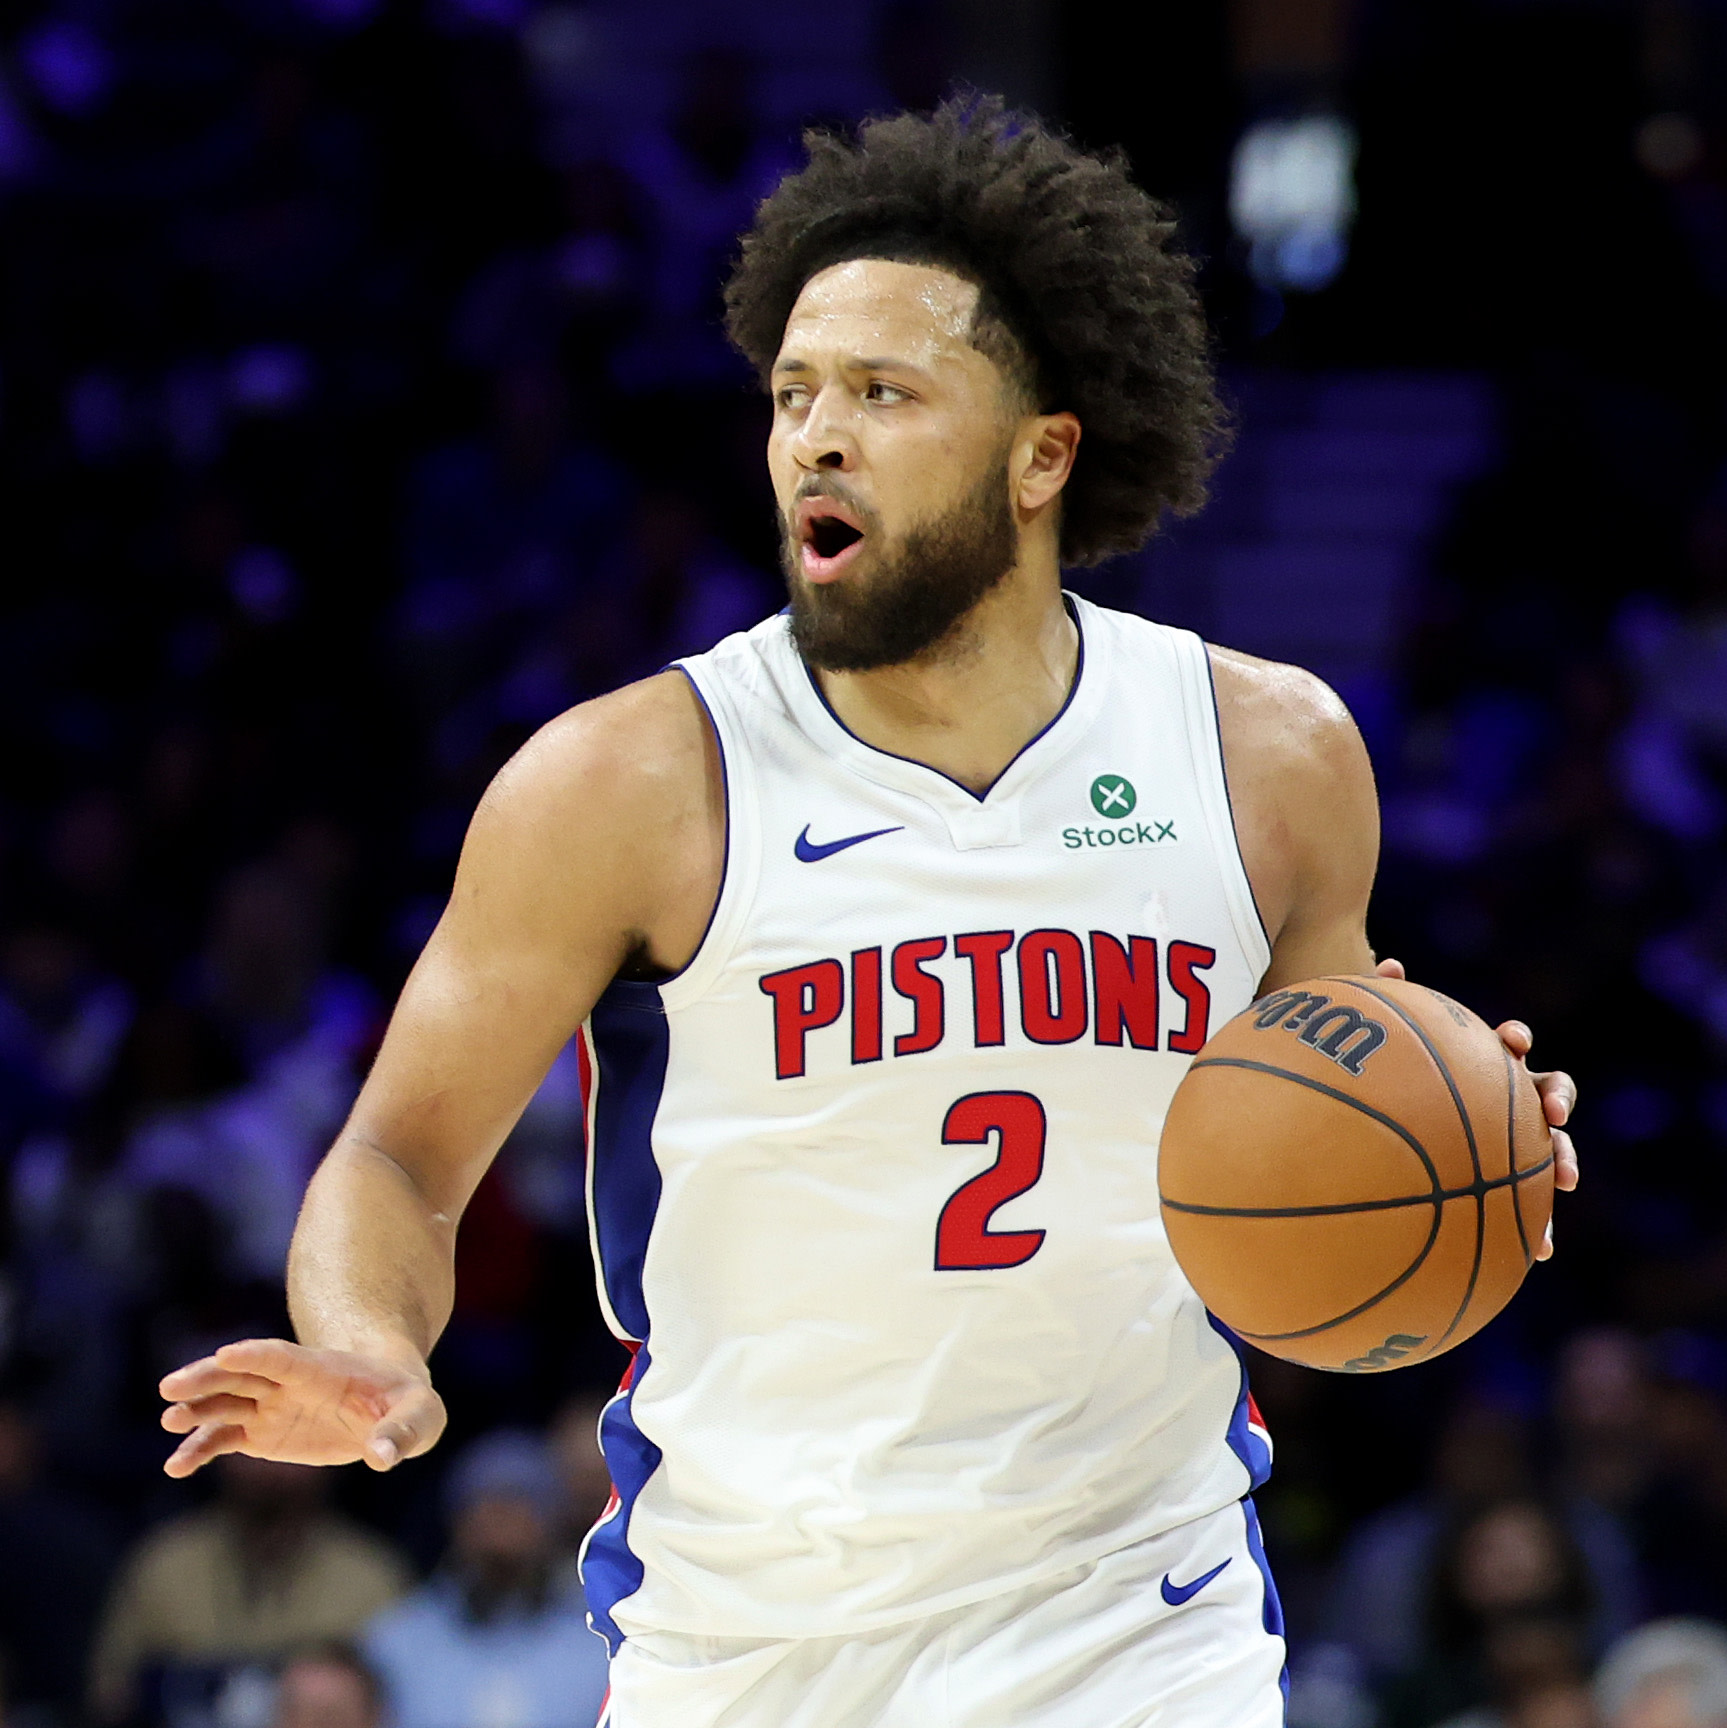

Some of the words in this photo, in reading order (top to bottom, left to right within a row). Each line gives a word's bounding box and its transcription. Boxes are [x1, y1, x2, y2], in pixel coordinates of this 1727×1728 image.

[1061, 819, 1178, 849] StockX
[758, 928, 1216, 1080] PISTONS
[1252, 990, 1389, 1077] Wil
[934, 1090, 1047, 1271] 2
